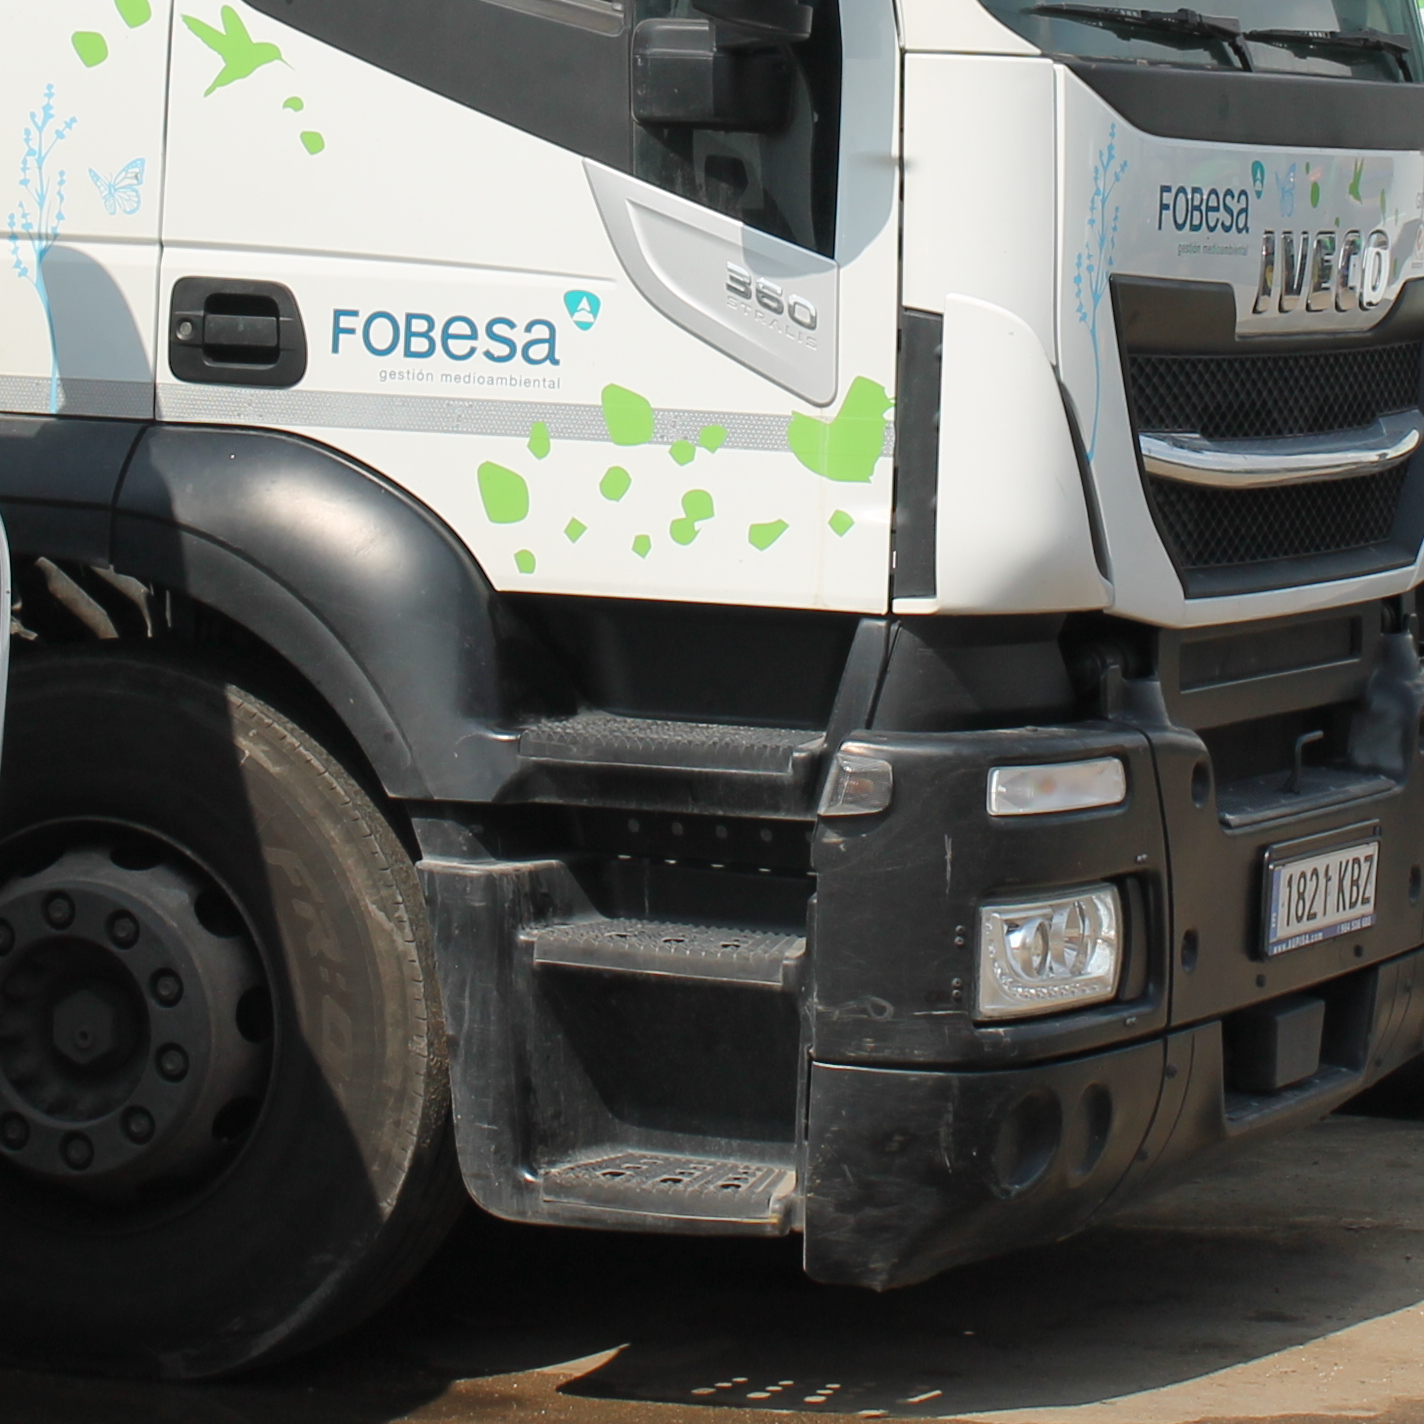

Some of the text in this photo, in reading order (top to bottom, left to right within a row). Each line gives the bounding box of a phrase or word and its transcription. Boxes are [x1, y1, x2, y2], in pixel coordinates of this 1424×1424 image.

[725, 260, 818, 331] 360
[1252, 228, 1390, 315] IVECO
[726, 295, 817, 351] STRALIS
[378, 368, 560, 390] gestión medioambiental
[1286, 854, 1374, 927] 1821 KBZ
